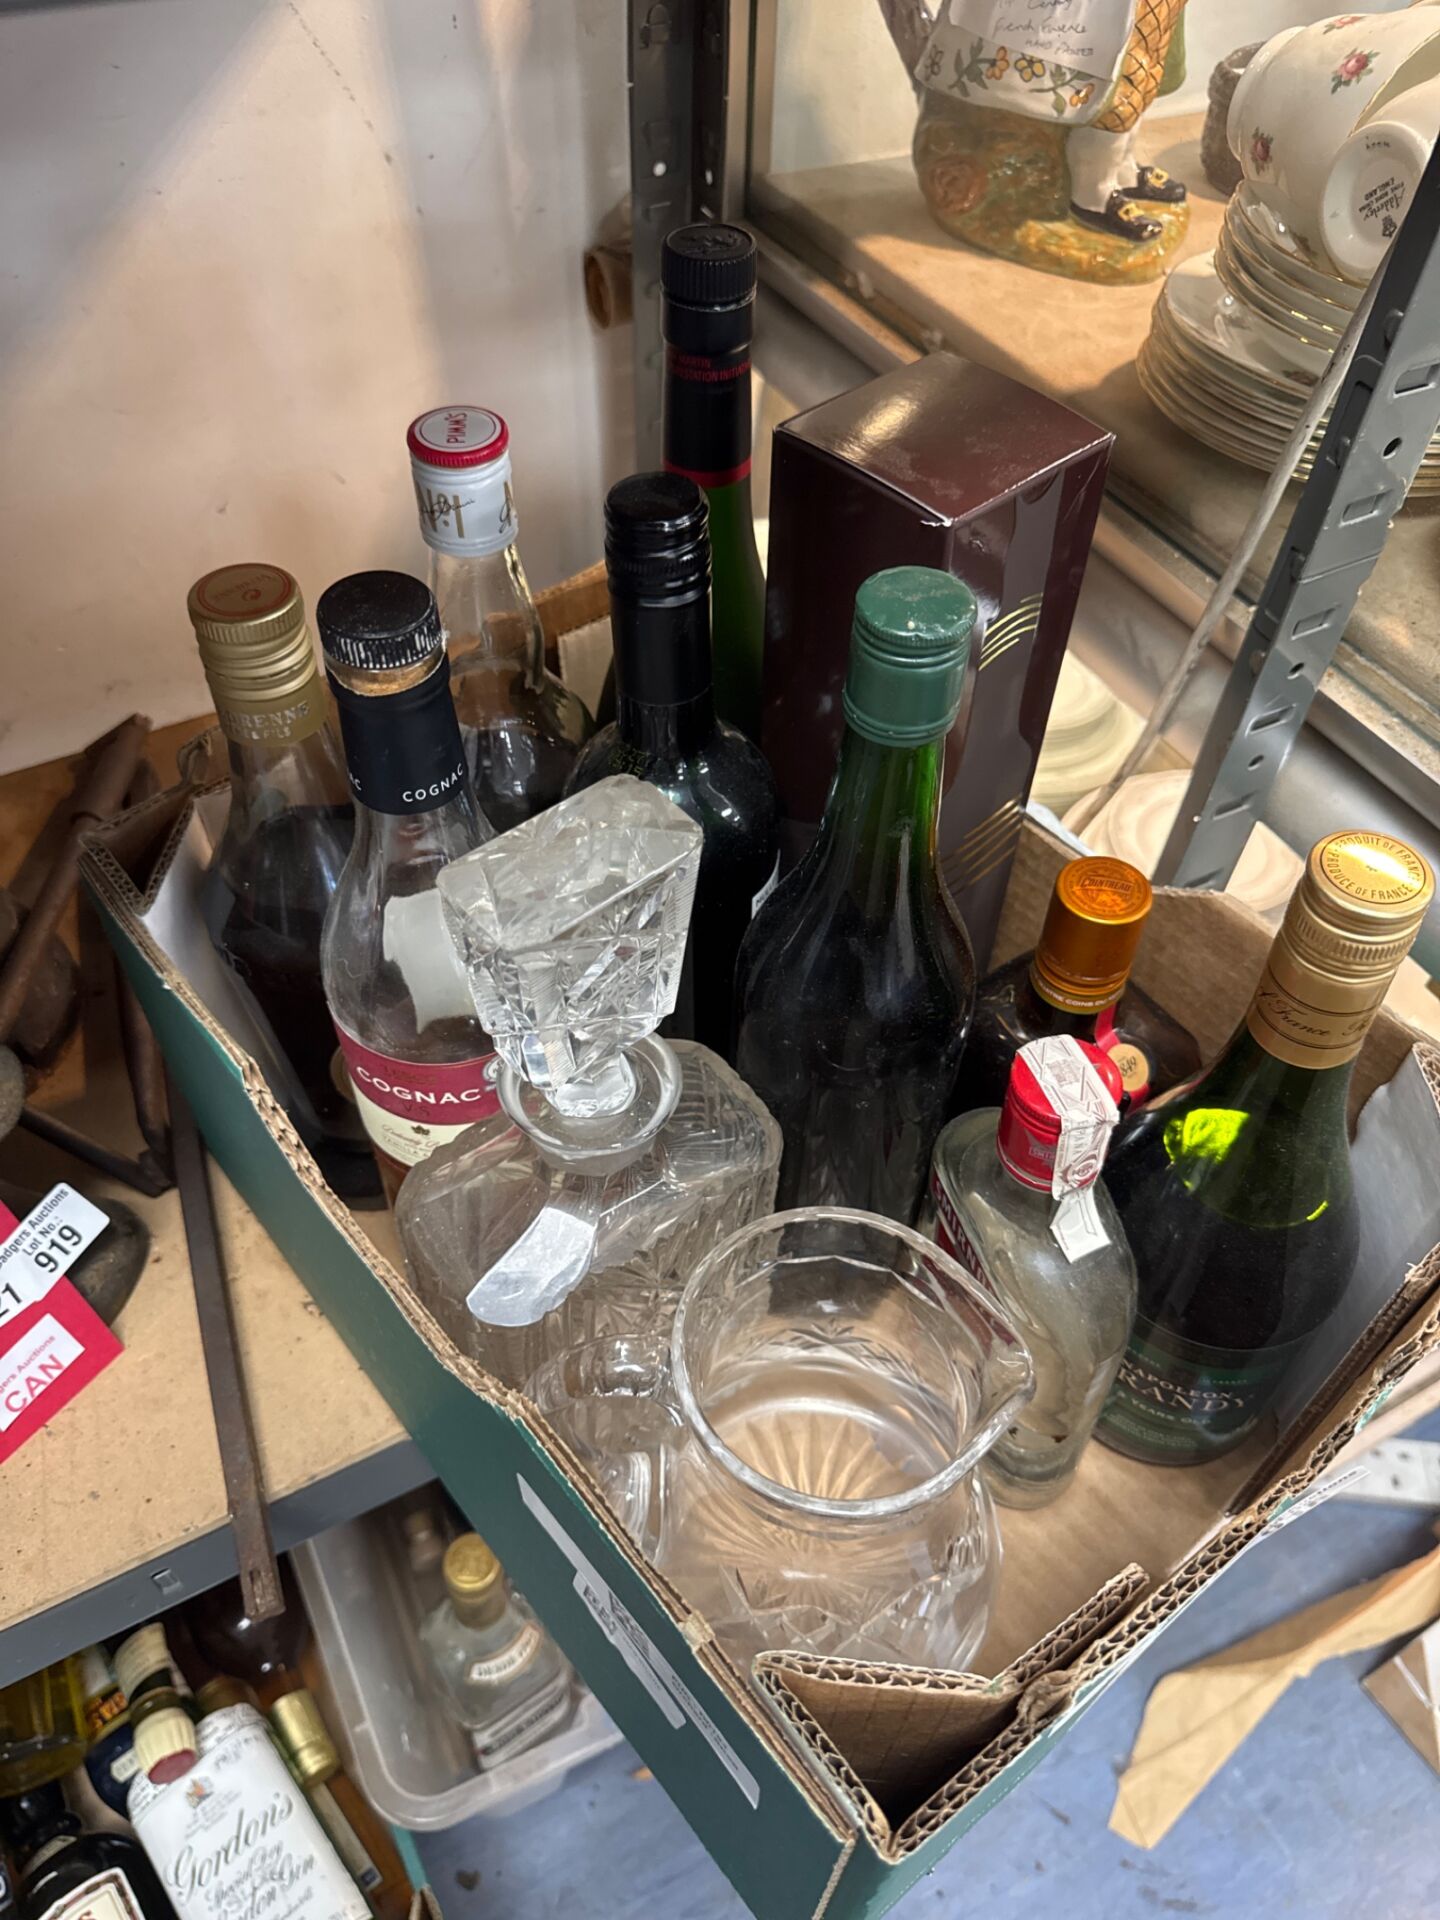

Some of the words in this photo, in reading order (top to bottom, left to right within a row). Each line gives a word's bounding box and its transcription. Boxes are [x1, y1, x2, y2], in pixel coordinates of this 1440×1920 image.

[444, 412, 468, 444] PIMM'S
[402, 763, 463, 802] COGNAC
[1080, 876, 1133, 892] COINTREAU
[1326, 851, 1356, 890] PRODUCE
[1355, 886, 1368, 896] OF
[1371, 883, 1413, 900] FRANCE
[356, 1066, 481, 1105] COGNAC
[28, 1188, 69, 1230] Auctions
[22, 1238, 42, 1256] Lot
[34, 1225, 82, 1273] 919
[17, 1336, 55, 1372] Auctions
[1118, 1367, 1255, 1411] RANDY
[1121, 1358, 1233, 1399] NAPOLEON
[163, 1792, 293, 1903] Gordon's
